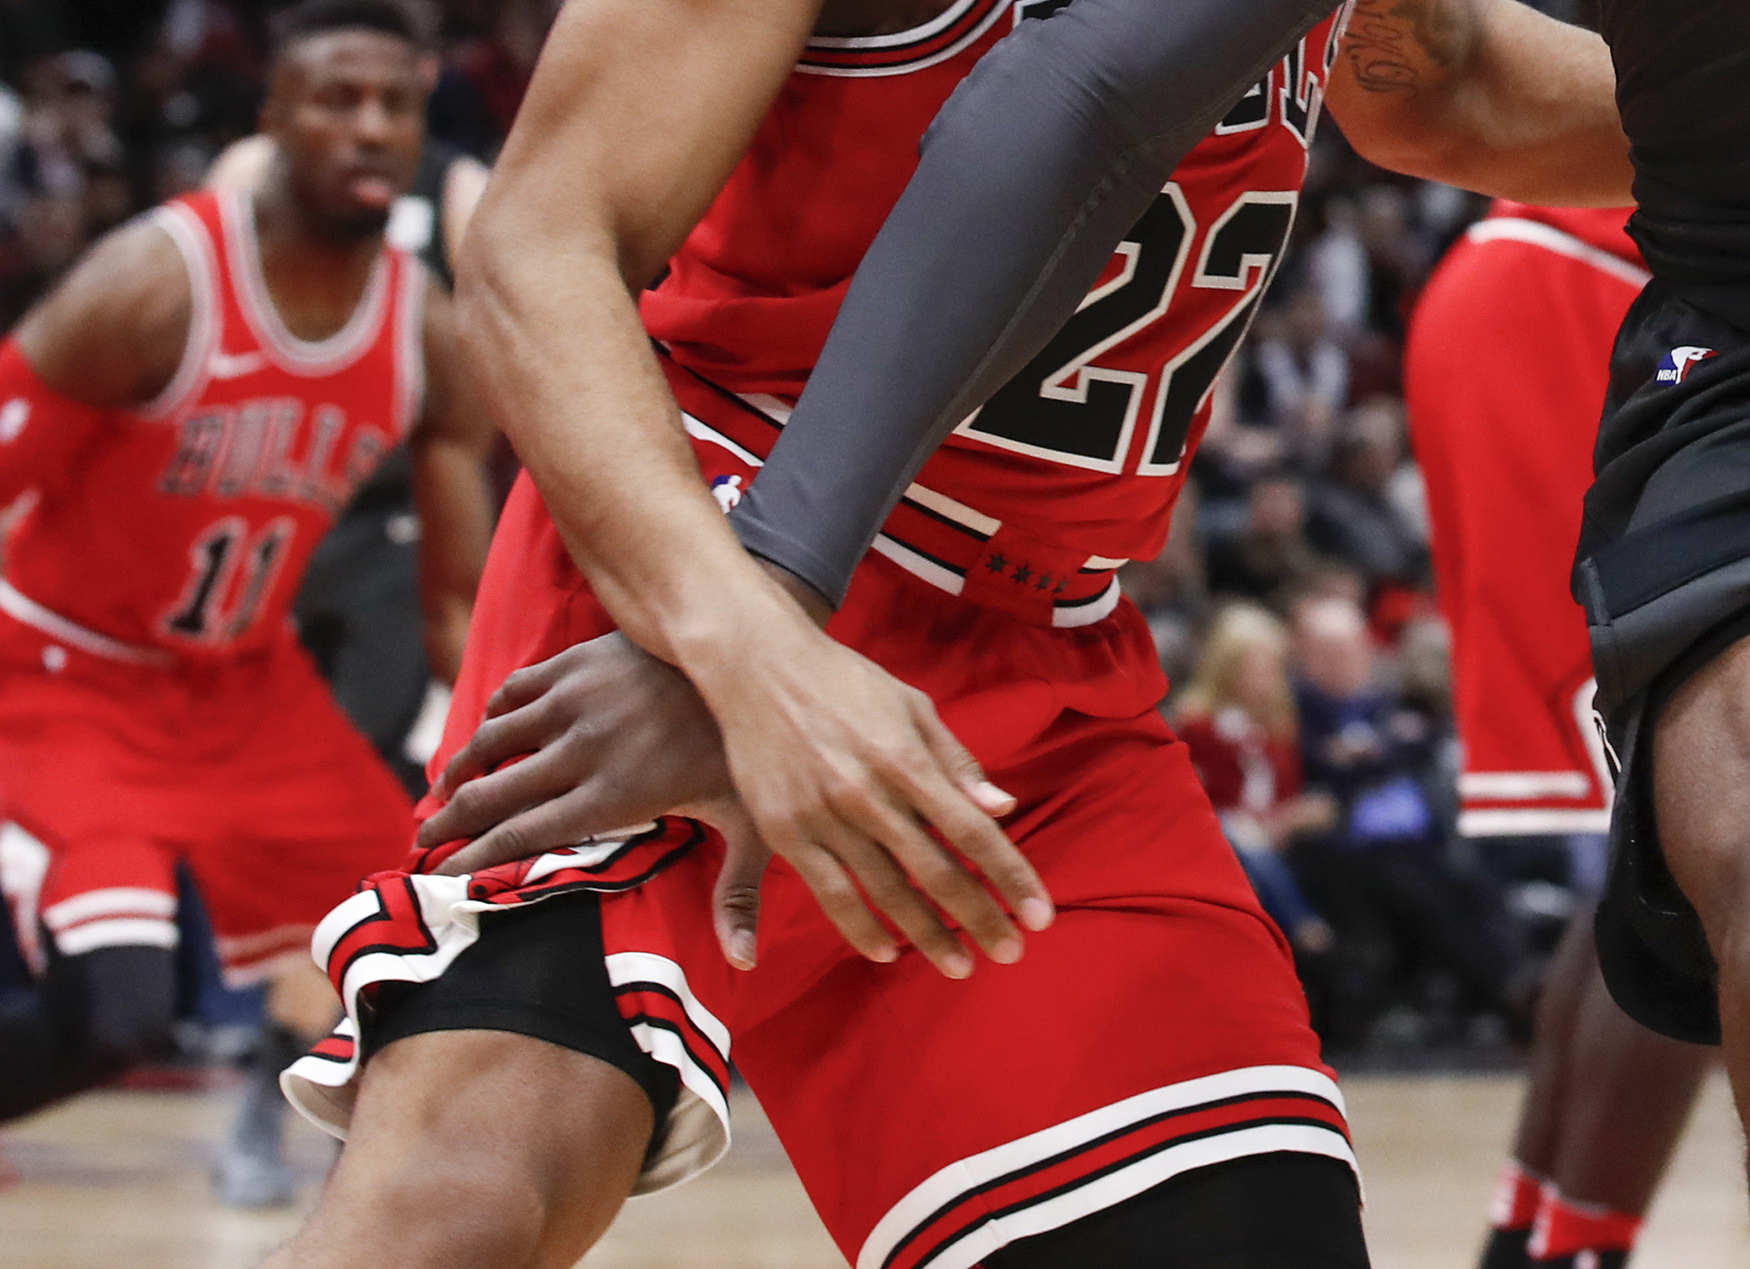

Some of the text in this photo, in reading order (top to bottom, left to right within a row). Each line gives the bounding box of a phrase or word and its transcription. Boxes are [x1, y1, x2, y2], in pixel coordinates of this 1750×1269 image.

[952, 180, 1299, 477] 22
[1656, 369, 1678, 382] NBA
[160, 516, 298, 642] 11
